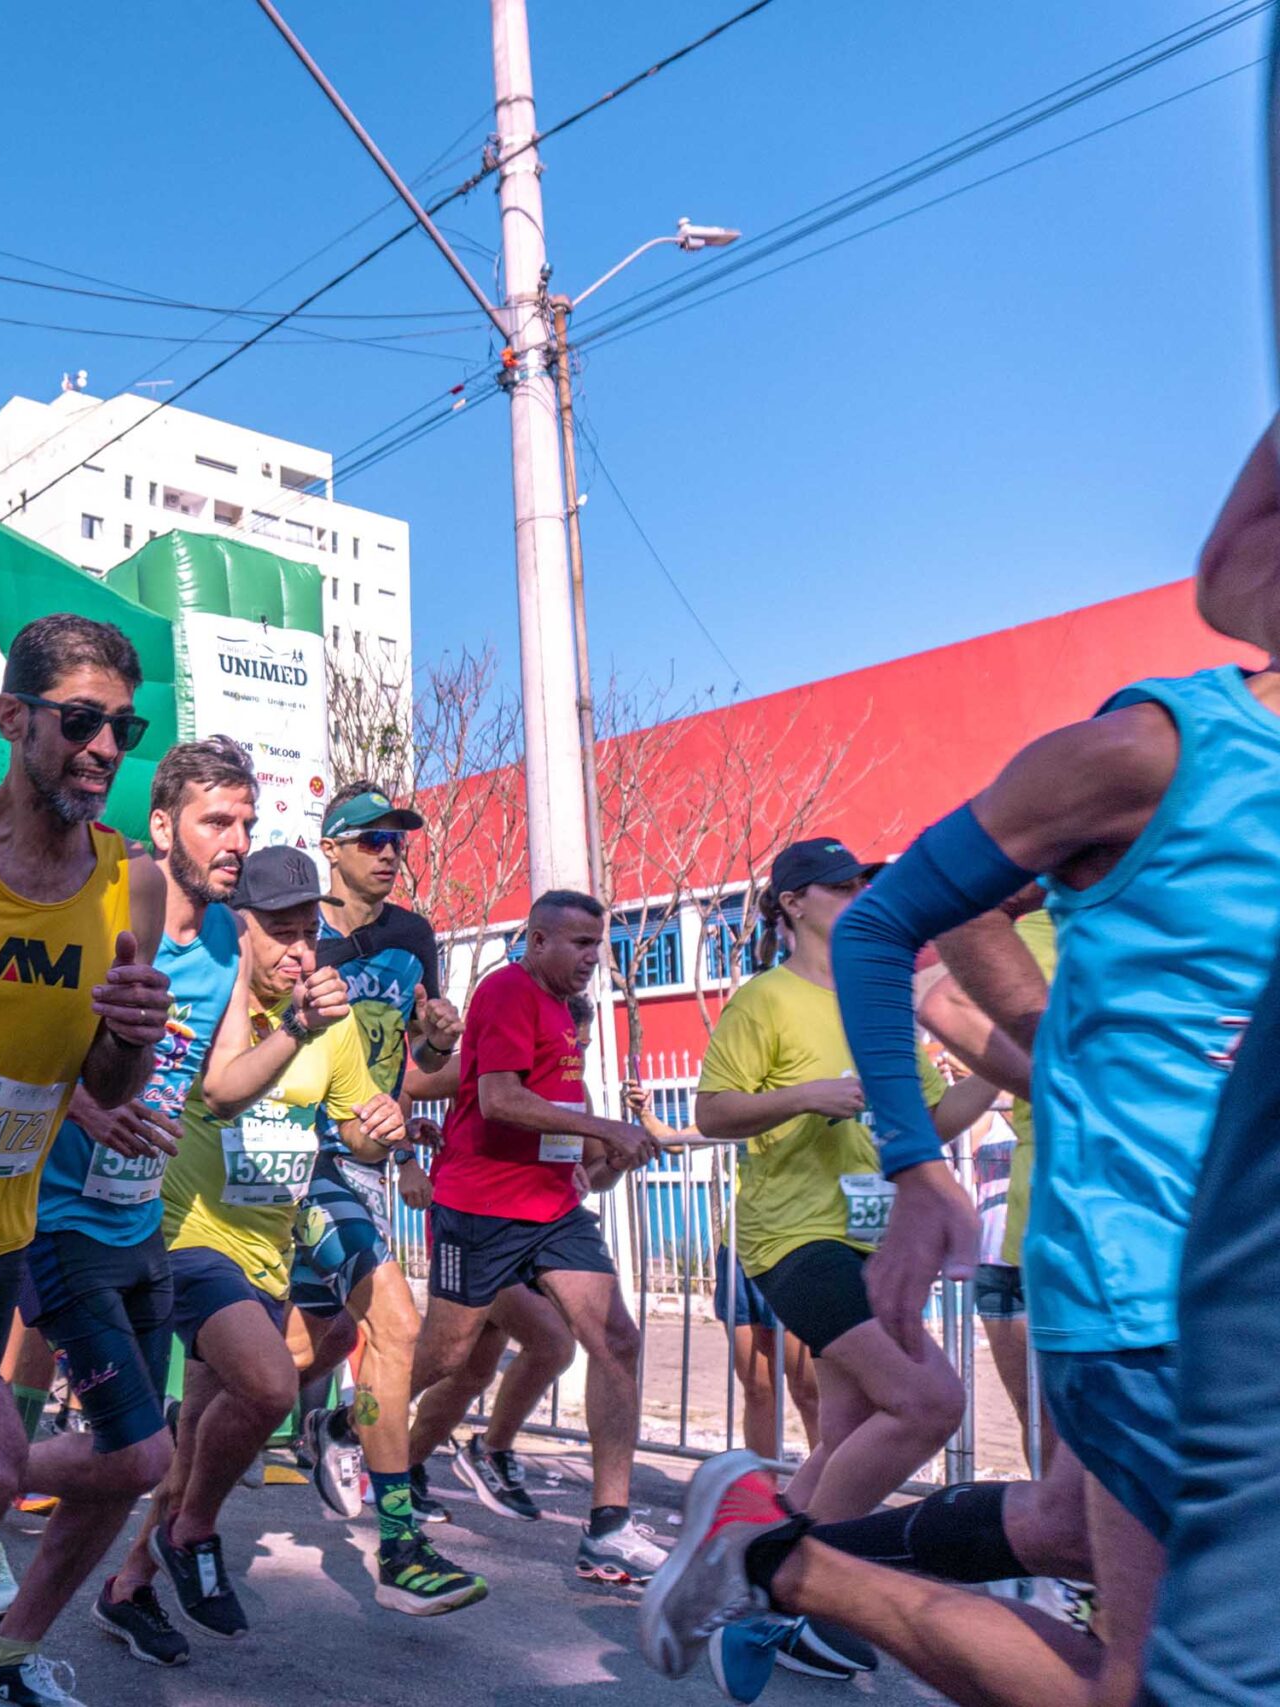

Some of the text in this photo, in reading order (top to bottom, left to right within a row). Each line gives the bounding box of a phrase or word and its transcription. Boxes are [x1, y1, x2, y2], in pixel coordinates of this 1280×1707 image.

[218, 653, 308, 686] UNIMED
[236, 1152, 308, 1183] 5256
[850, 1196, 895, 1227] 537
